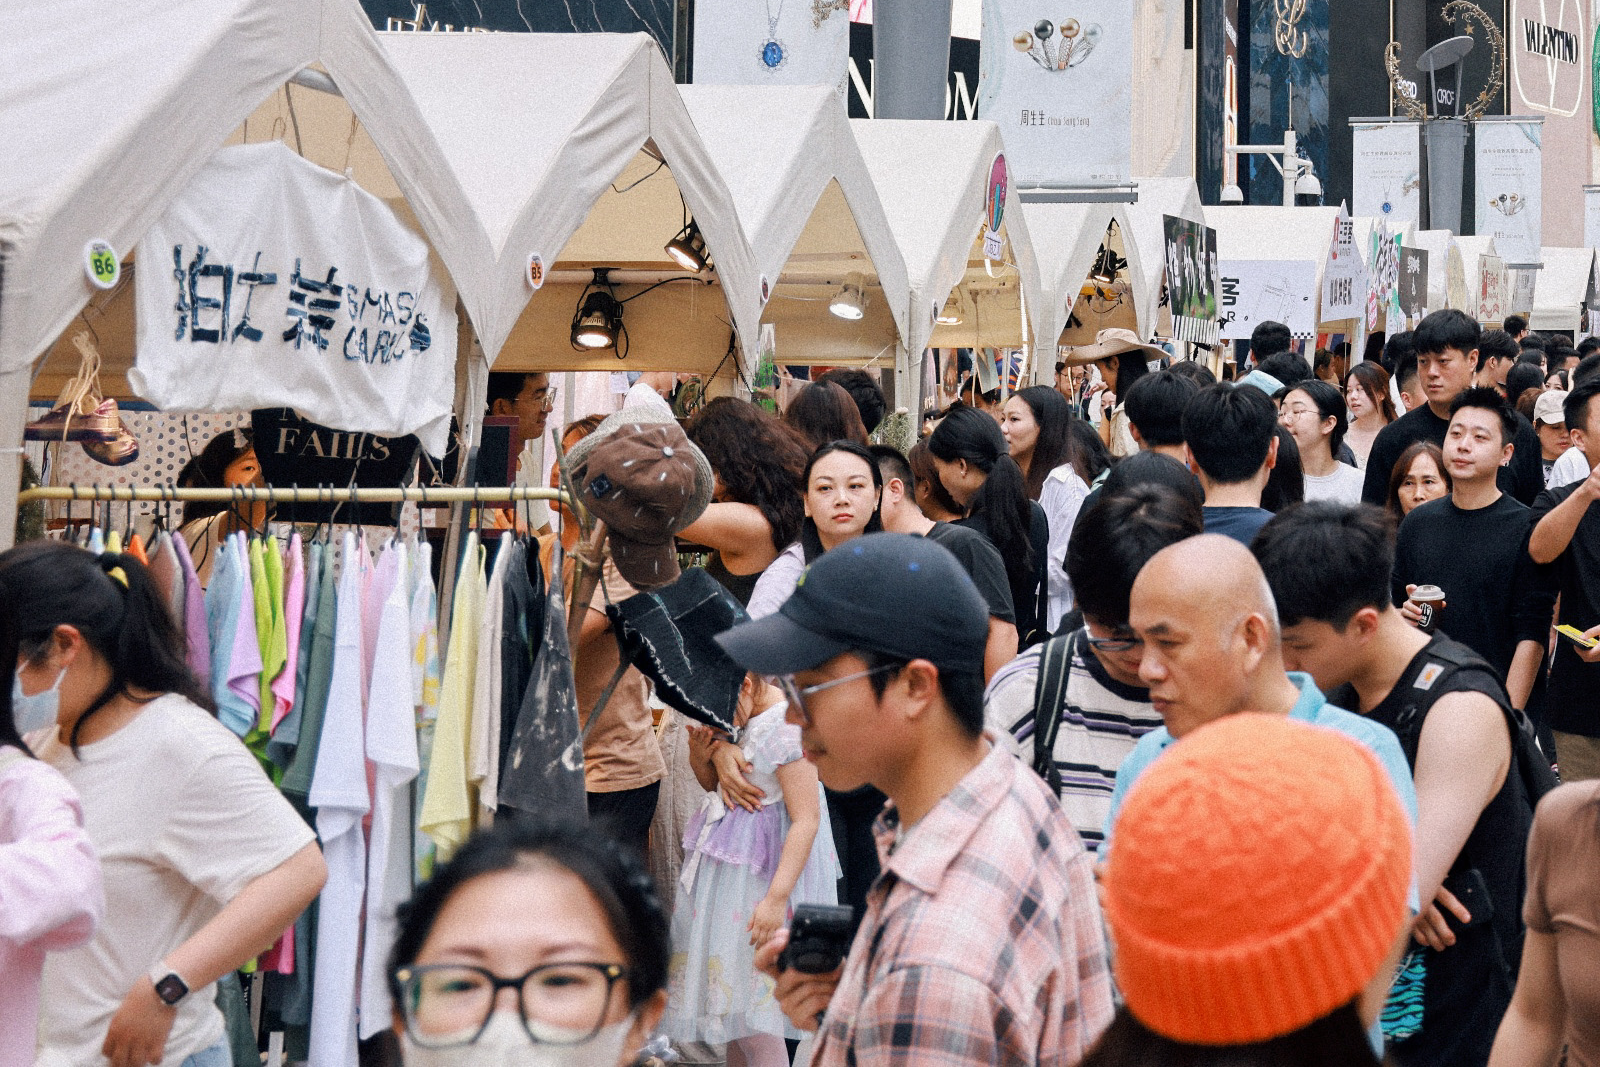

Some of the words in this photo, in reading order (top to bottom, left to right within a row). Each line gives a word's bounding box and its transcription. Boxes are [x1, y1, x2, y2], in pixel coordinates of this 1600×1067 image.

[1521, 18, 1578, 64] VALENTINO
[1020, 109, 1045, 126] 周生生
[94, 257, 114, 275] B6
[531, 267, 541, 279] B5
